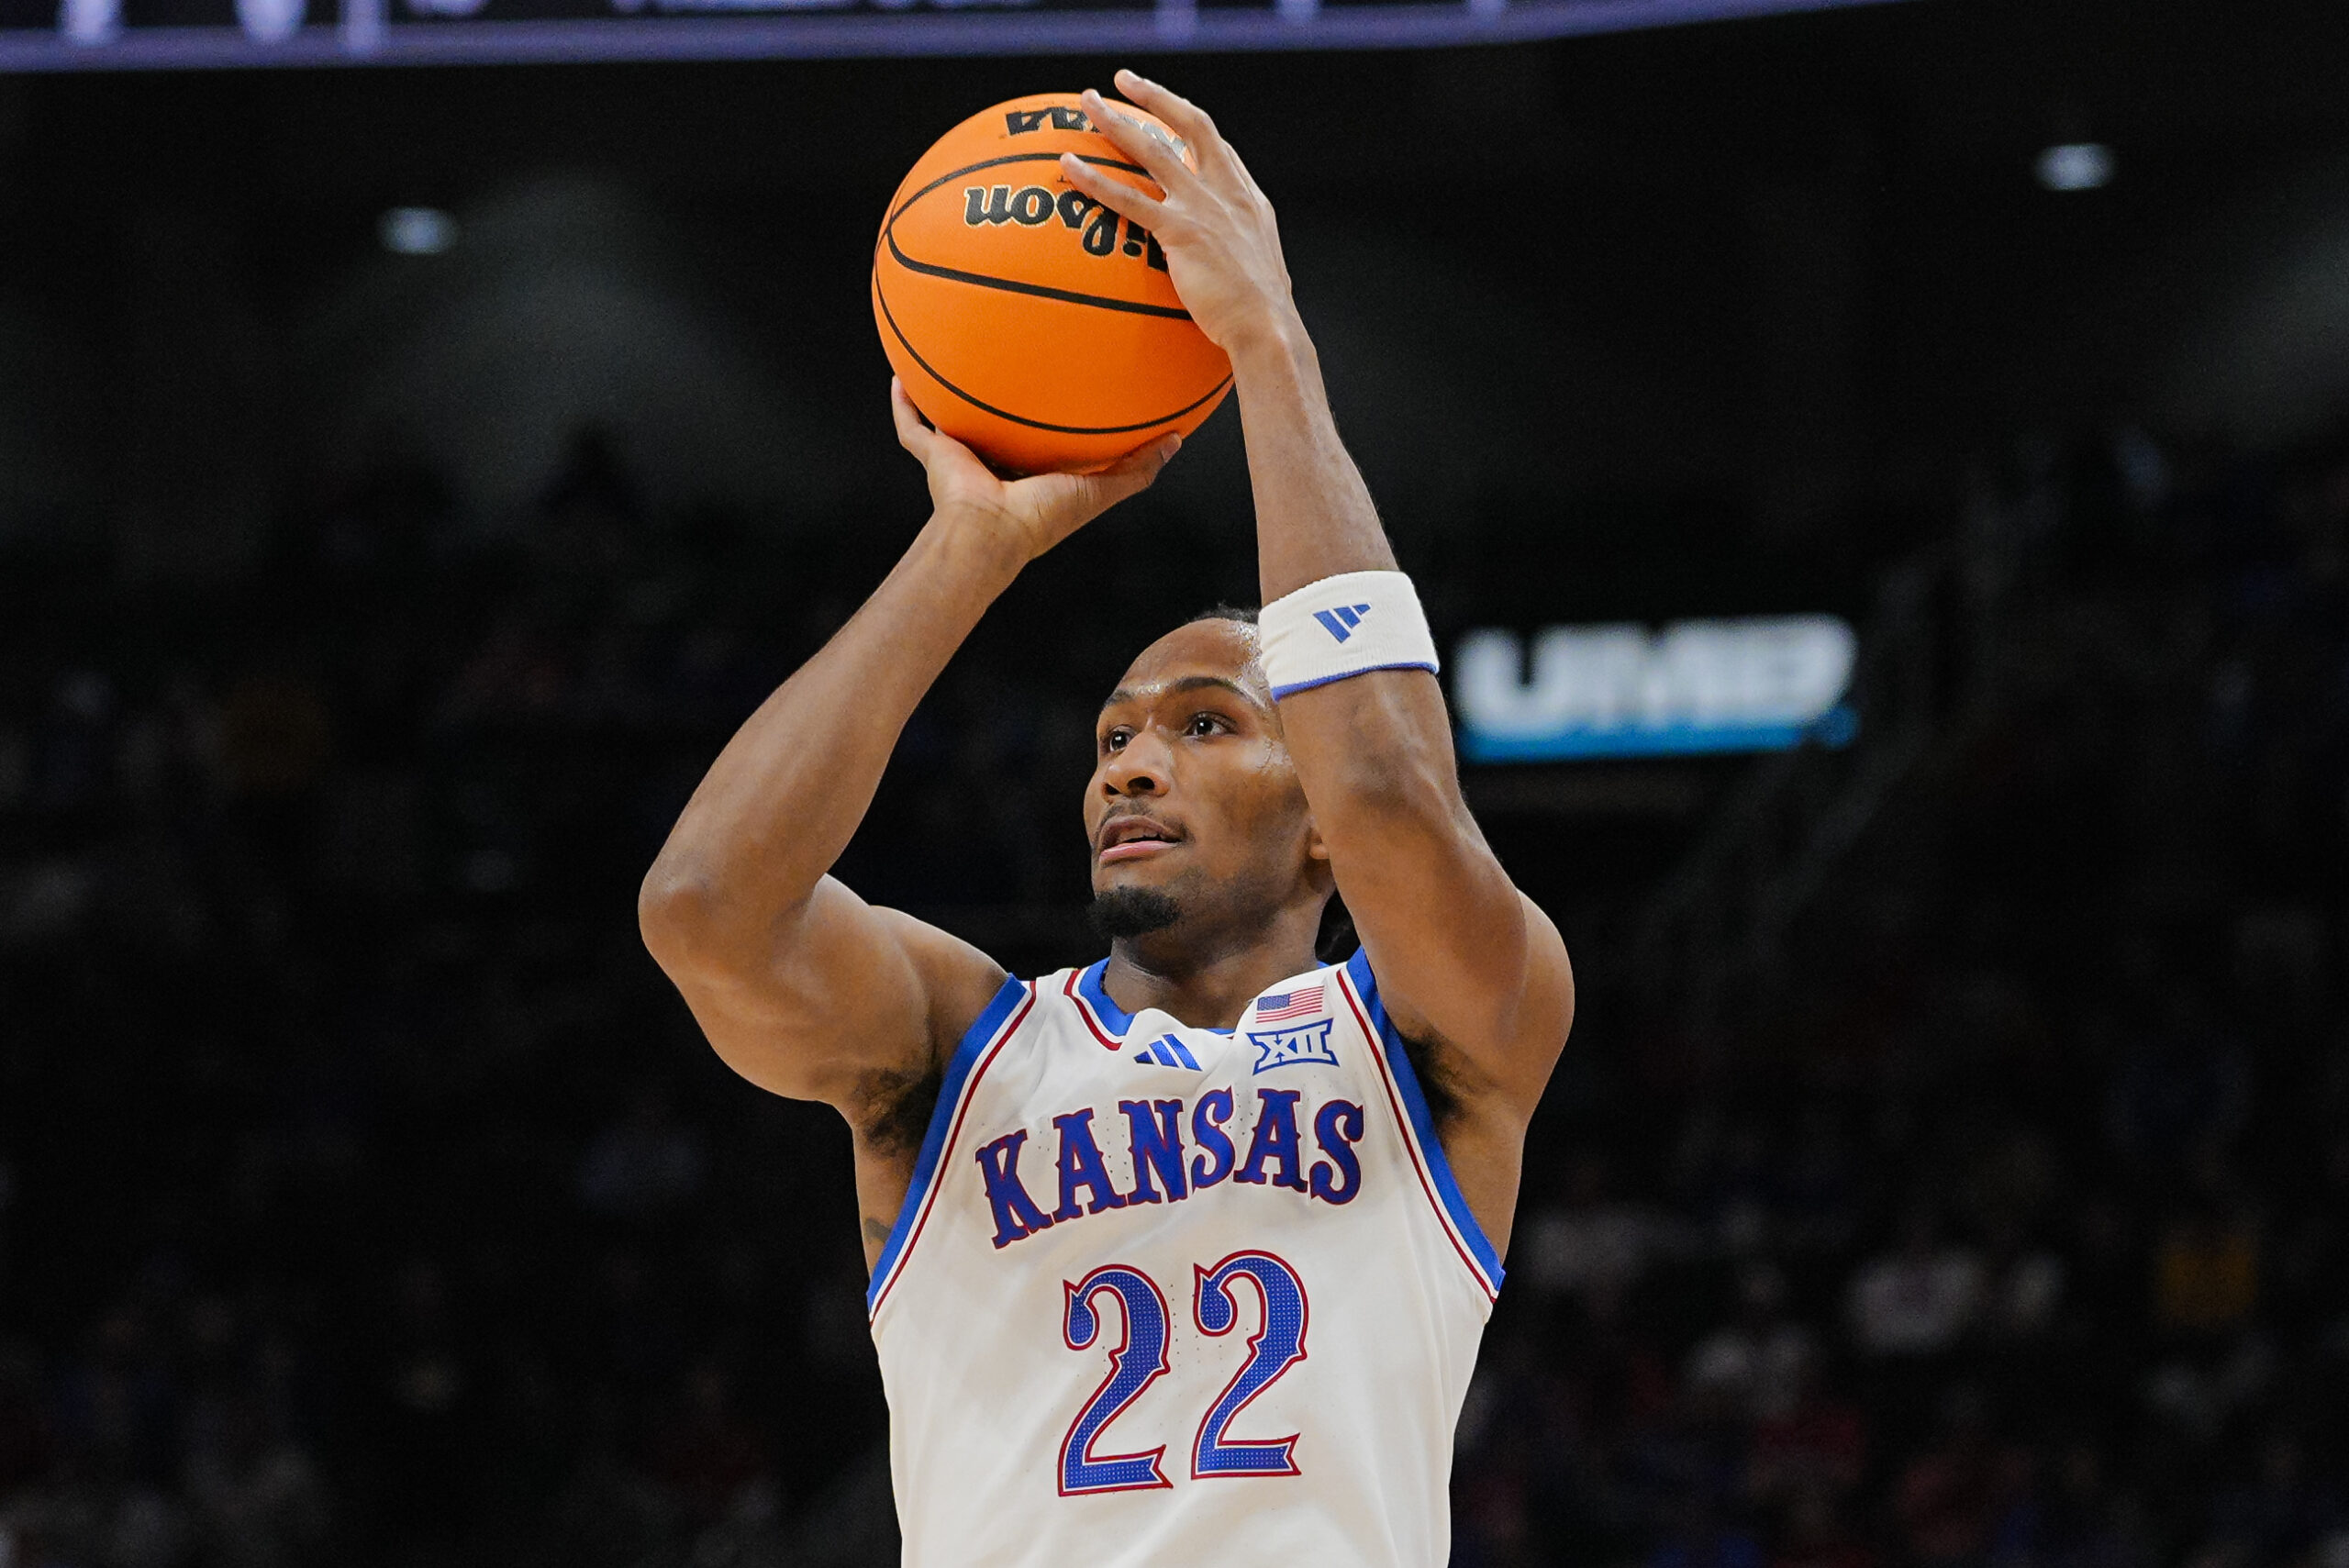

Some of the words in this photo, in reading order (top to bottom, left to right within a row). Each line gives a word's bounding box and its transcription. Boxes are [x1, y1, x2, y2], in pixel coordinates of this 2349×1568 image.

[964, 183, 1170, 272] ilson
[1245, 1017, 1340, 1076] XII
[974, 1084, 1364, 1250] KANSAS
[1058, 1249, 1309, 1497] 22
